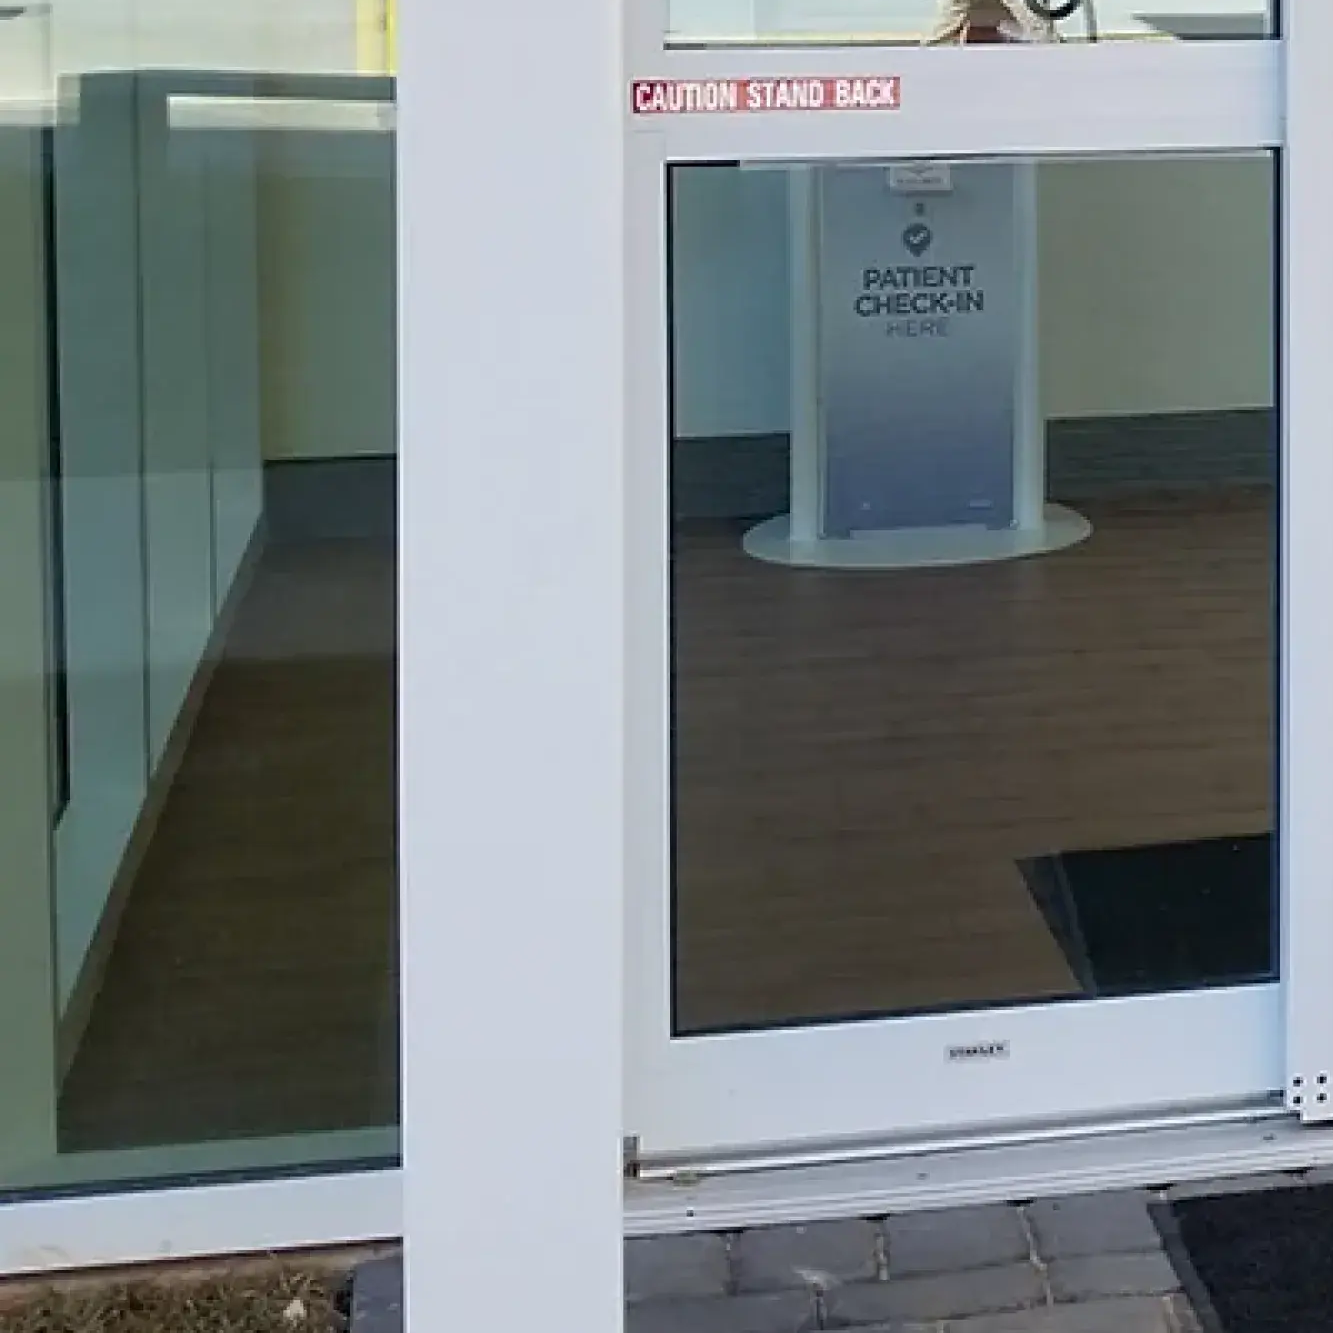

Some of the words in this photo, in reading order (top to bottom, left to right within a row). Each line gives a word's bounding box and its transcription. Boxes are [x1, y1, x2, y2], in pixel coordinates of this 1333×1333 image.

[636, 82, 738, 111] CAUTION
[746, 80, 824, 108] STAND
[835, 78, 895, 106] BACK
[862, 267, 975, 289] PATIENT
[855, 290, 984, 316] CHECK-IN
[886, 319, 951, 338] HERE
